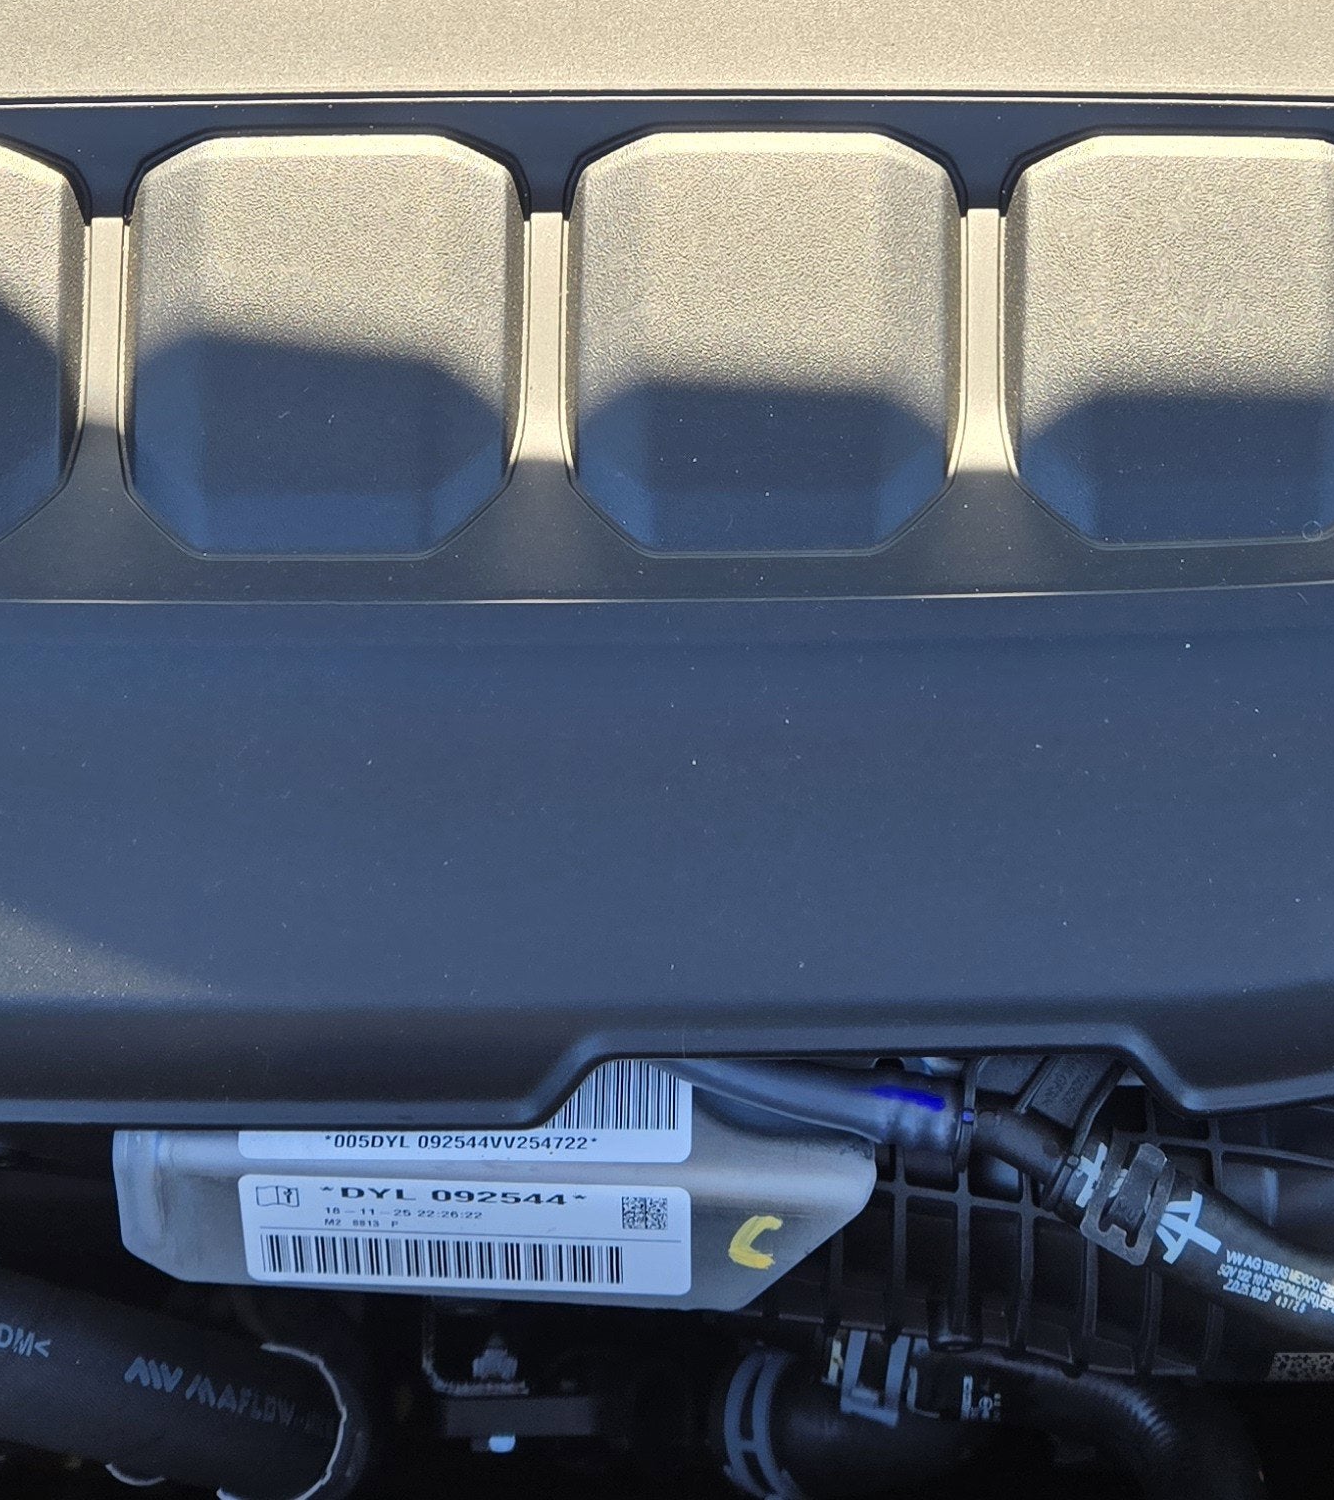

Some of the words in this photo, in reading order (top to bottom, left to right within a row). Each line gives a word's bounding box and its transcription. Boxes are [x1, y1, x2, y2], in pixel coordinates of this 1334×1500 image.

[360, 1208, 375, 1216] 11
[1226, 1250, 1246, 1266] VW
[1244, 1254, 1261, 1271] AG
